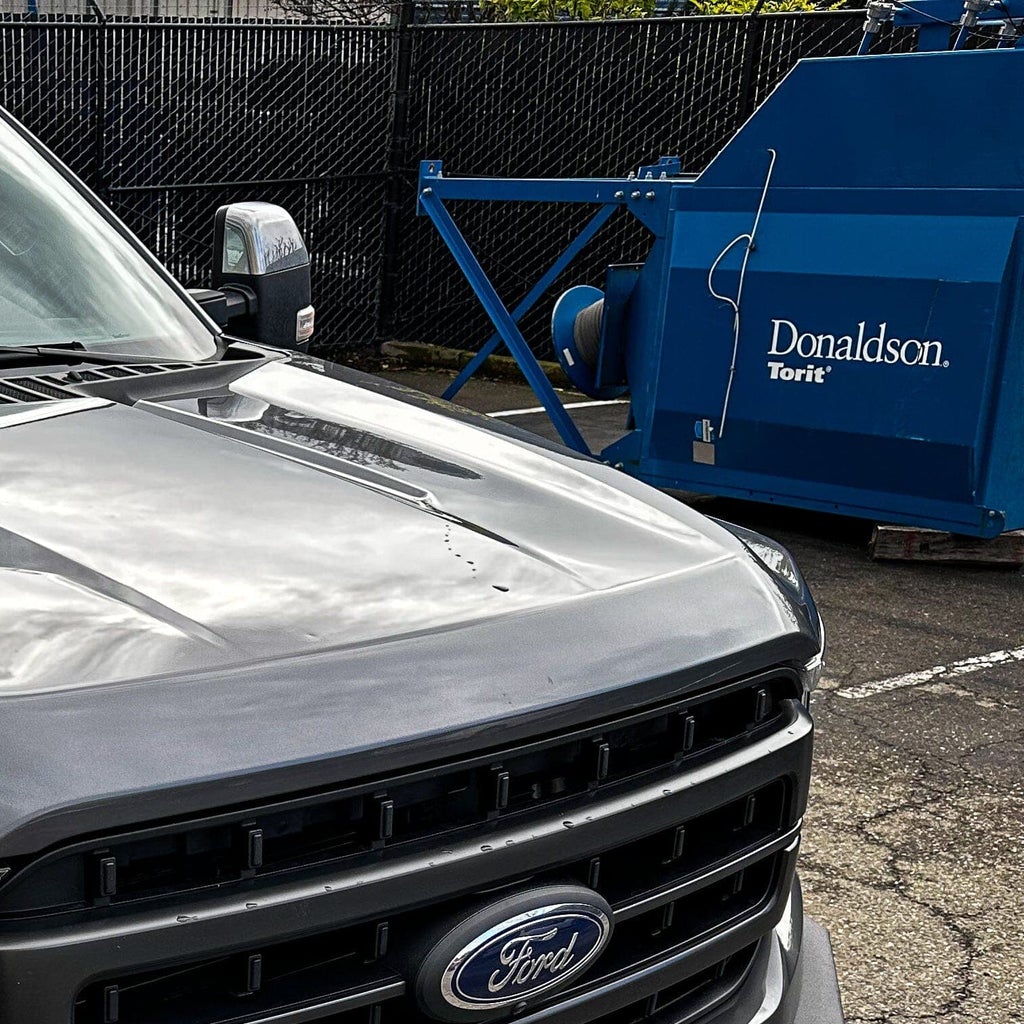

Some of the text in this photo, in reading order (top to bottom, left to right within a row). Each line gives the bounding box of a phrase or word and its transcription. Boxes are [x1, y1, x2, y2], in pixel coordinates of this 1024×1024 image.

[767, 319, 943, 367] Donaldson
[767, 361, 825, 383] Torit
[487, 927, 579, 993] Ford
